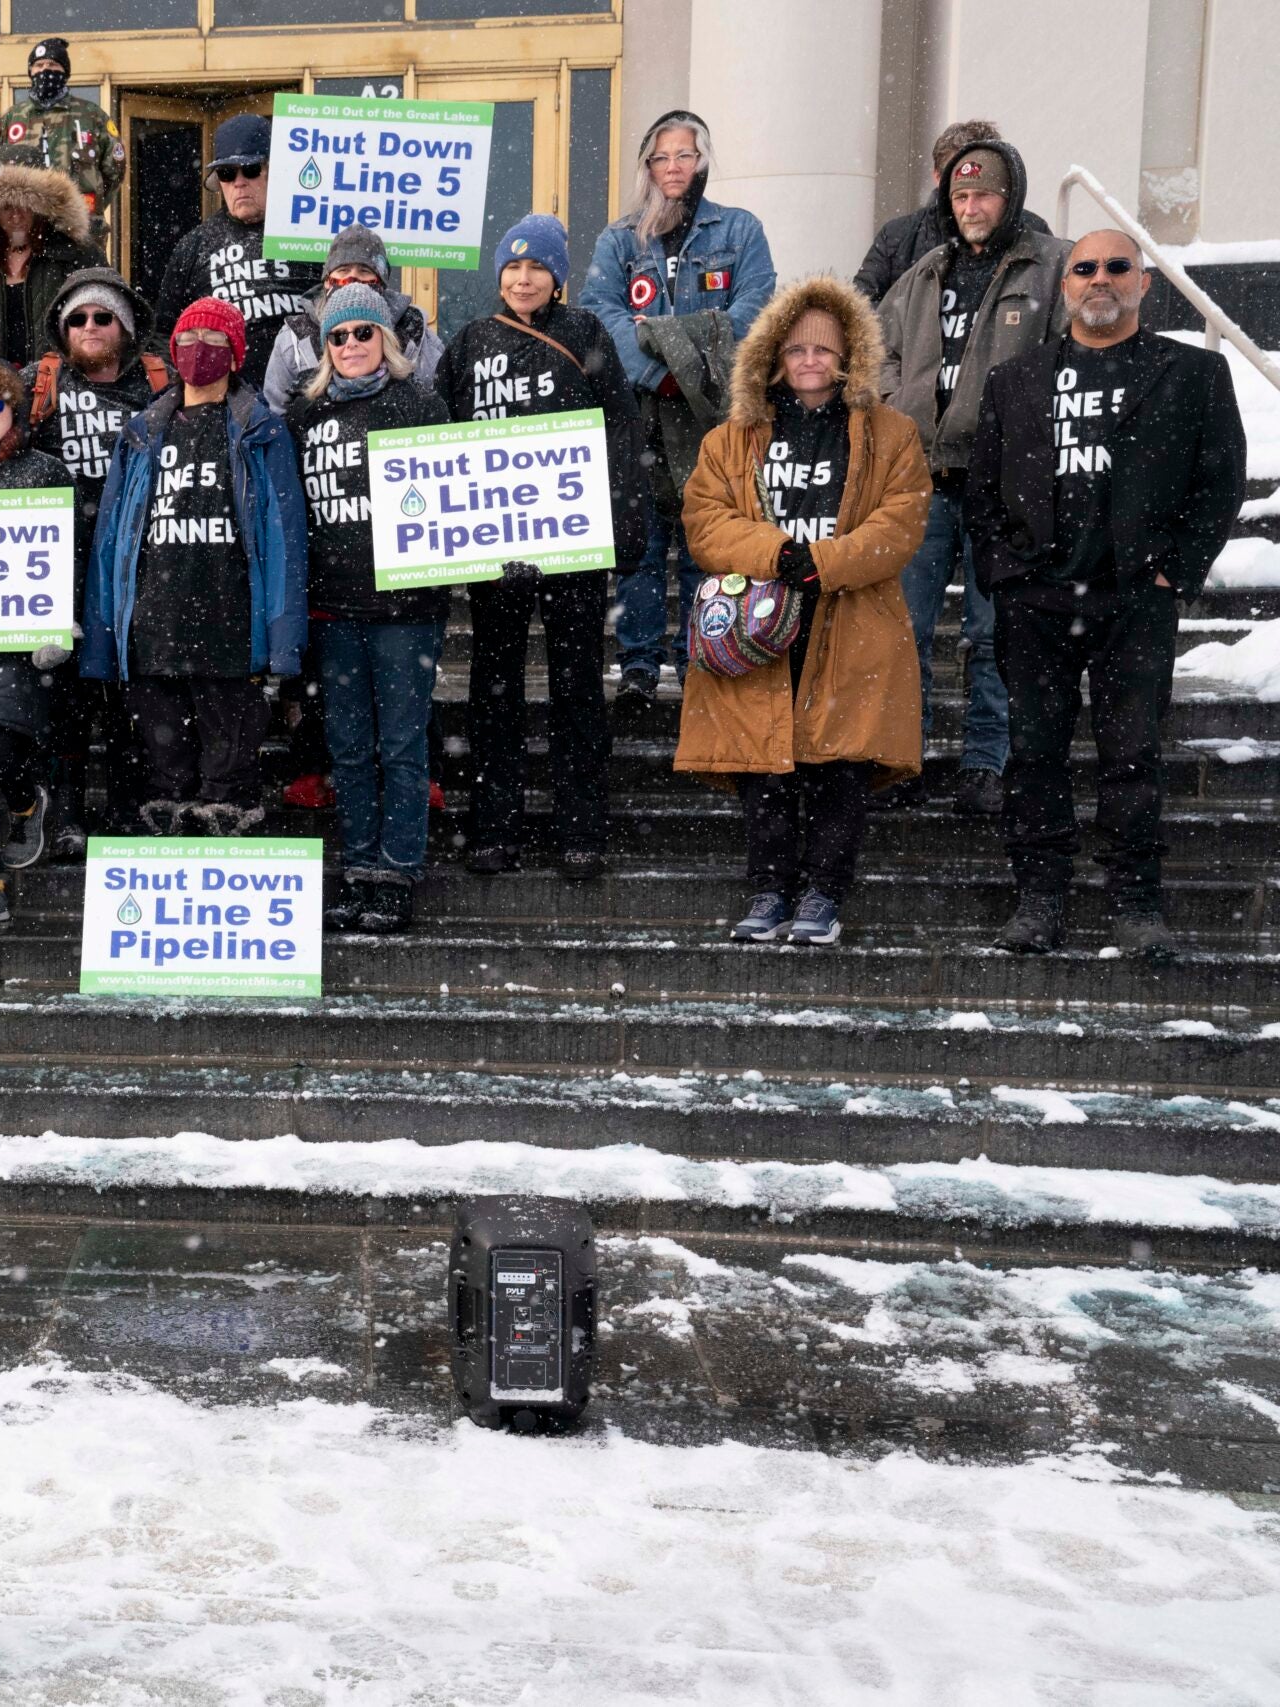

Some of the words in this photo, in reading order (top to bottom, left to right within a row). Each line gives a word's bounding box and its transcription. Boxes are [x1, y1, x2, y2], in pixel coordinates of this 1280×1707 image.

[288, 104, 318, 116] Keep
[322, 105, 338, 116] Oil
[343, 106, 363, 117] Out
[367, 108, 379, 118] of
[383, 108, 402, 119] the
[406, 109, 439, 120] Great
[444, 111, 479, 122] Lakes
[288, 127, 366, 155] Shut
[378, 132, 472, 160] Down
[334, 162, 421, 194] Line
[436, 167, 461, 196] 5
[291, 195, 460, 234] Pipeline
[210, 244, 243, 271] NO
[210, 259, 268, 288] LINE
[274, 260, 290, 278] 5
[474, 354, 508, 384] NO
[60, 390, 97, 414] NO
[474, 376, 532, 409] LINE
[538, 370, 554, 397] 5
[61, 411, 123, 439] LINE
[306, 419, 339, 448] NO
[378, 435, 413, 448] Keep
[417, 433, 435, 444] Oil
[439, 431, 463, 442] Out
[467, 429, 481, 439] of
[484, 426, 507, 437] the
[511, 422, 548, 435] Great
[552, 418, 593, 430] Lakes
[62, 436, 109, 461] OIL
[304, 441, 361, 475] LINE
[200, 462, 216, 486] 5
[383, 452, 470, 483] Shut
[485, 445, 591, 473] Down
[812, 461, 831, 485] 5
[26, 495, 64, 506] Lakes
[305, 472, 345, 500] OIL
[439, 482, 539, 514] Line
[557, 471, 584, 501] 5
[396, 512, 590, 557] Pipeline
[25, 551, 51, 580] 5
[102, 846, 135, 857] Keep
[139, 846, 157, 856] Oil
[161, 846, 183, 857] Out
[187, 846, 200, 857] of
[204, 846, 225, 857] the
[229, 846, 265, 857] Great
[270, 847, 307, 857] Lakes
[104, 867, 187, 891] Shut
[202, 868, 303, 892] Down
[155, 898, 251, 925] Line
[267, 898, 294, 927] 5
[110, 930, 296, 966] Pipeline
[97, 975, 305, 989] www.OilandWaterDontMix.org
